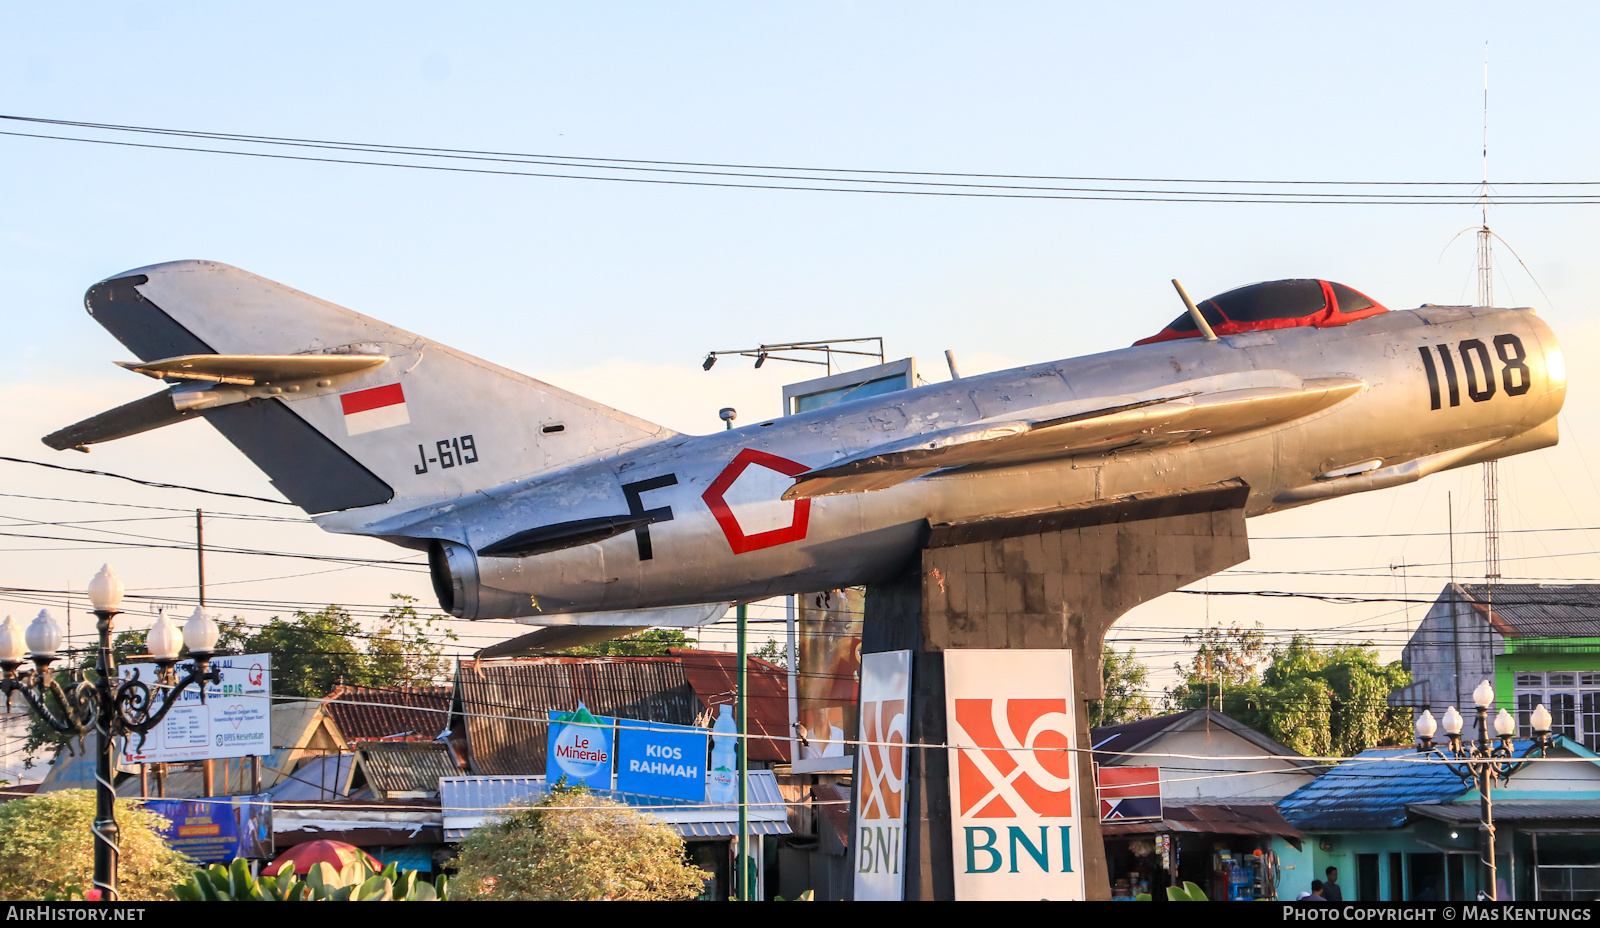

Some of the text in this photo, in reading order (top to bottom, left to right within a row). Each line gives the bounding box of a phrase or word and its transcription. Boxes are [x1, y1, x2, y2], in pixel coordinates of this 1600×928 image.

[1418, 333, 1531, 411] 1108
[414, 434, 479, 475] J-619
[621, 473, 679, 561] F
[223, 659, 233, 669] AU
[223, 684, 243, 698] BPJS
[223, 732, 265, 742] BPJS Kesehatan
[575, 735, 589, 749] Le
[556, 744, 608, 763] Minerale
[646, 744, 682, 760] KIOS
[629, 759, 698, 779] RAHMAH
[858, 826, 900, 875] BNI
[963, 825, 1075, 874] BNI
